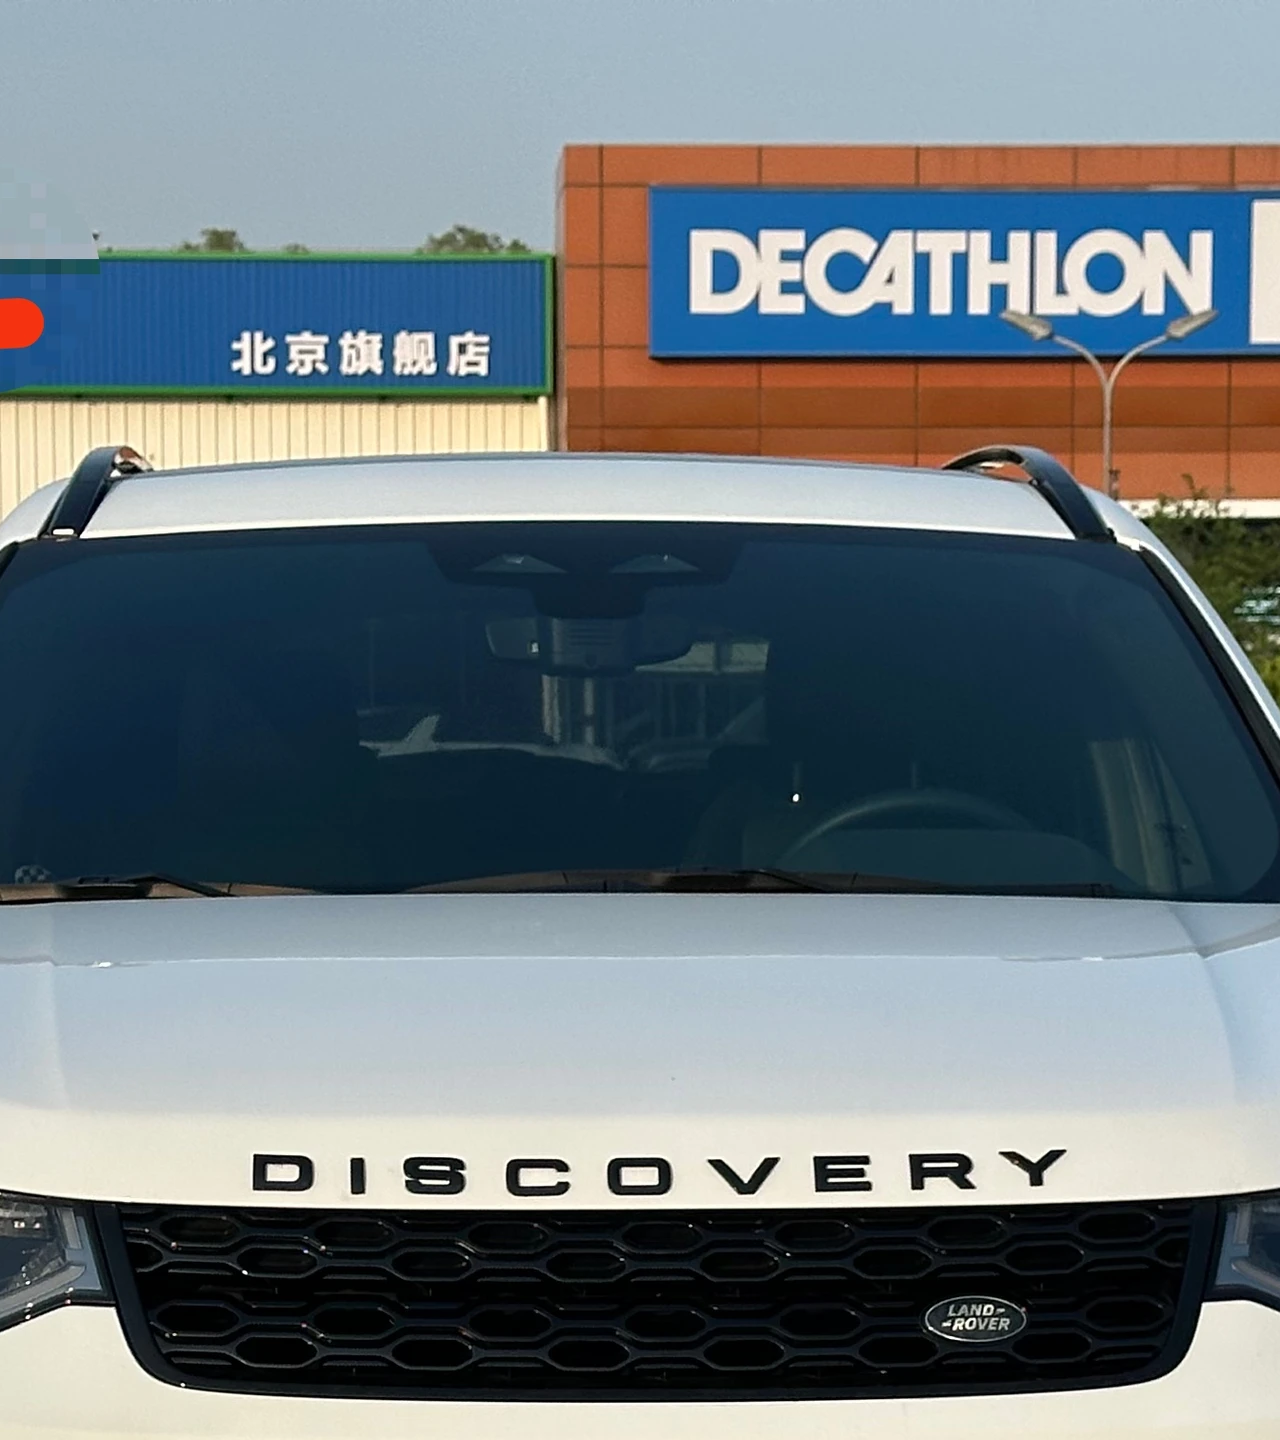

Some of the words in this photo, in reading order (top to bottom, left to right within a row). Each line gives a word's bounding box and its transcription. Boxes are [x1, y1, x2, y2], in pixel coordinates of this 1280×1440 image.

[689, 228, 1214, 316] DECATHLON
[230, 330, 490, 377] 北京旗舰店
[252, 1148, 1067, 1196] DISCOVERY
[947, 1304, 995, 1317] LAND
[951, 1317, 1011, 1331] ROVER
